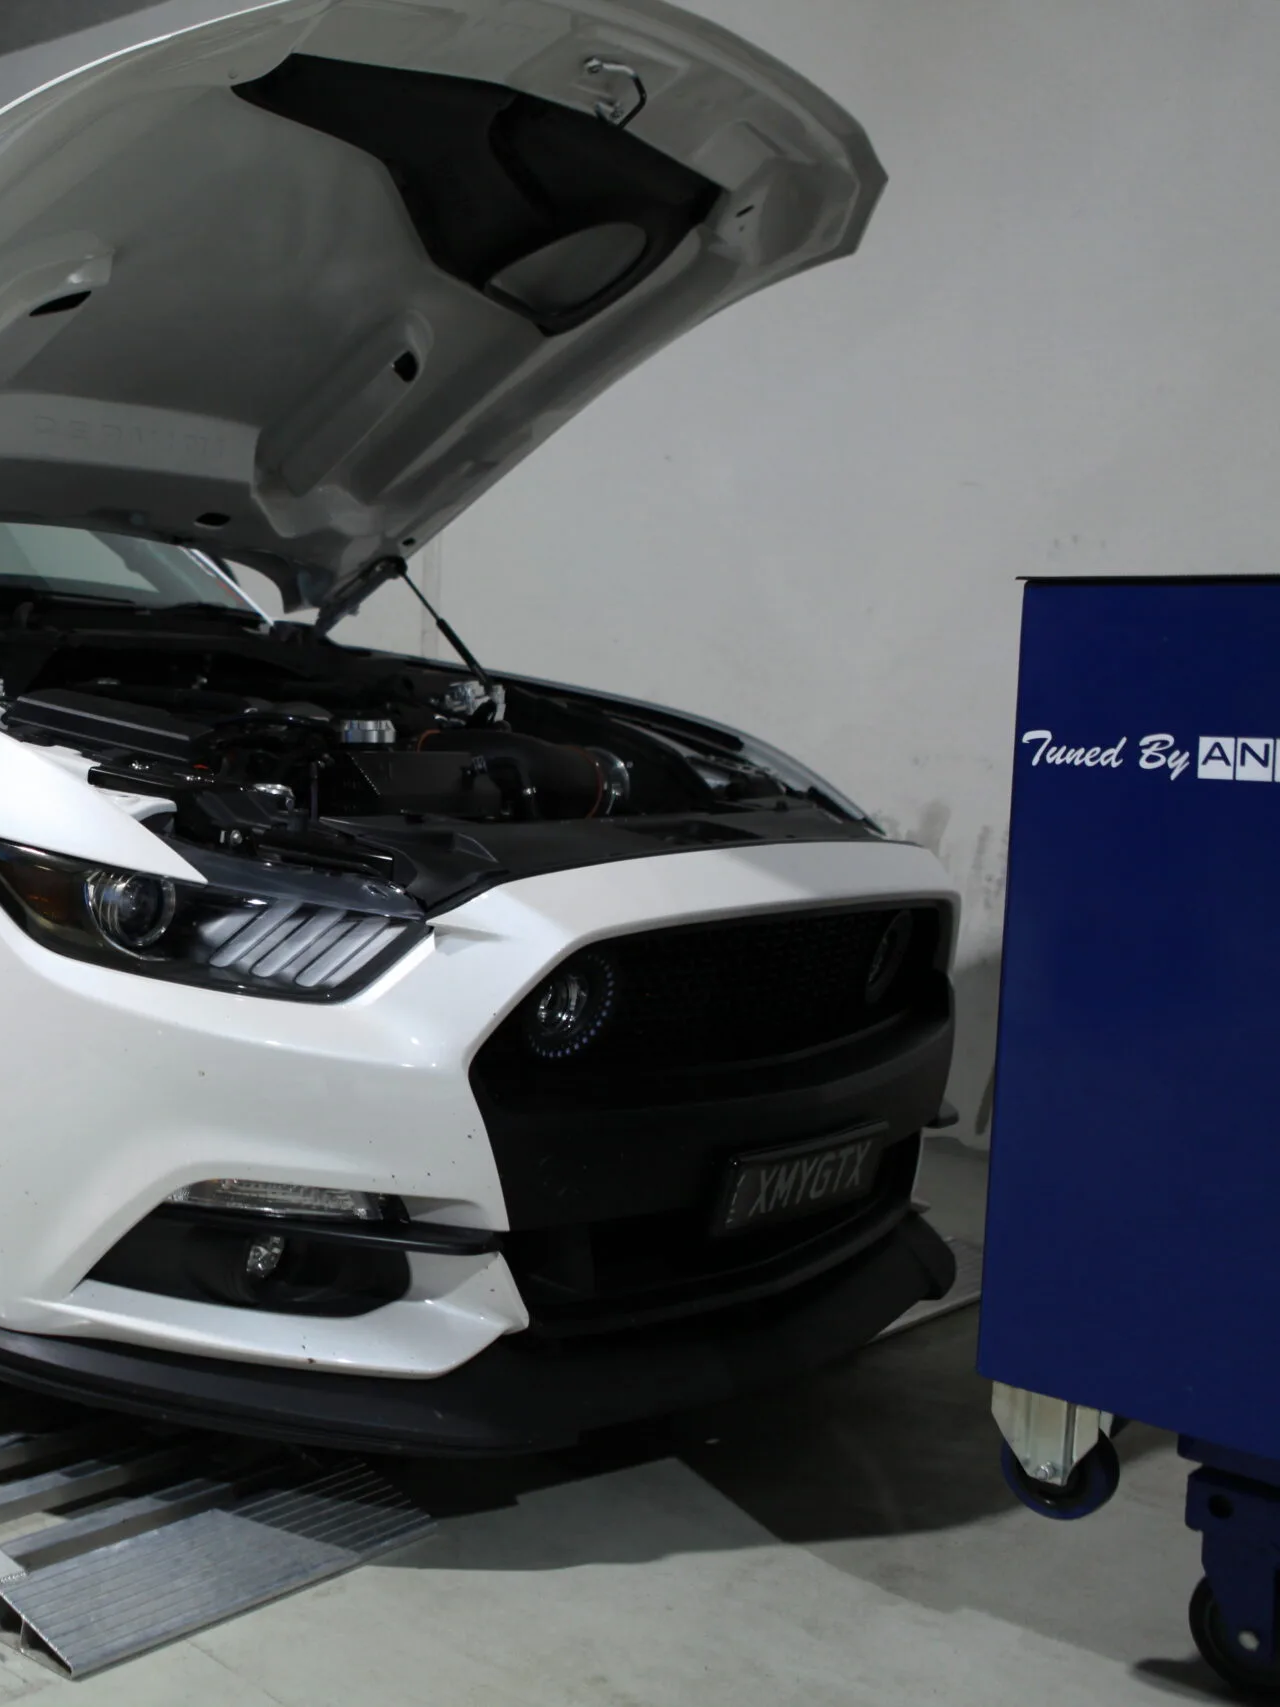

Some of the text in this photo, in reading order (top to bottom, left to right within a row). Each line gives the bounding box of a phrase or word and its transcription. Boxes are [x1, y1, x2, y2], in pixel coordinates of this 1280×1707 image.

[1022, 729, 1128, 769] Tuned
[1138, 733, 1191, 781] By
[747, 1139, 874, 1218] XMYGTX
